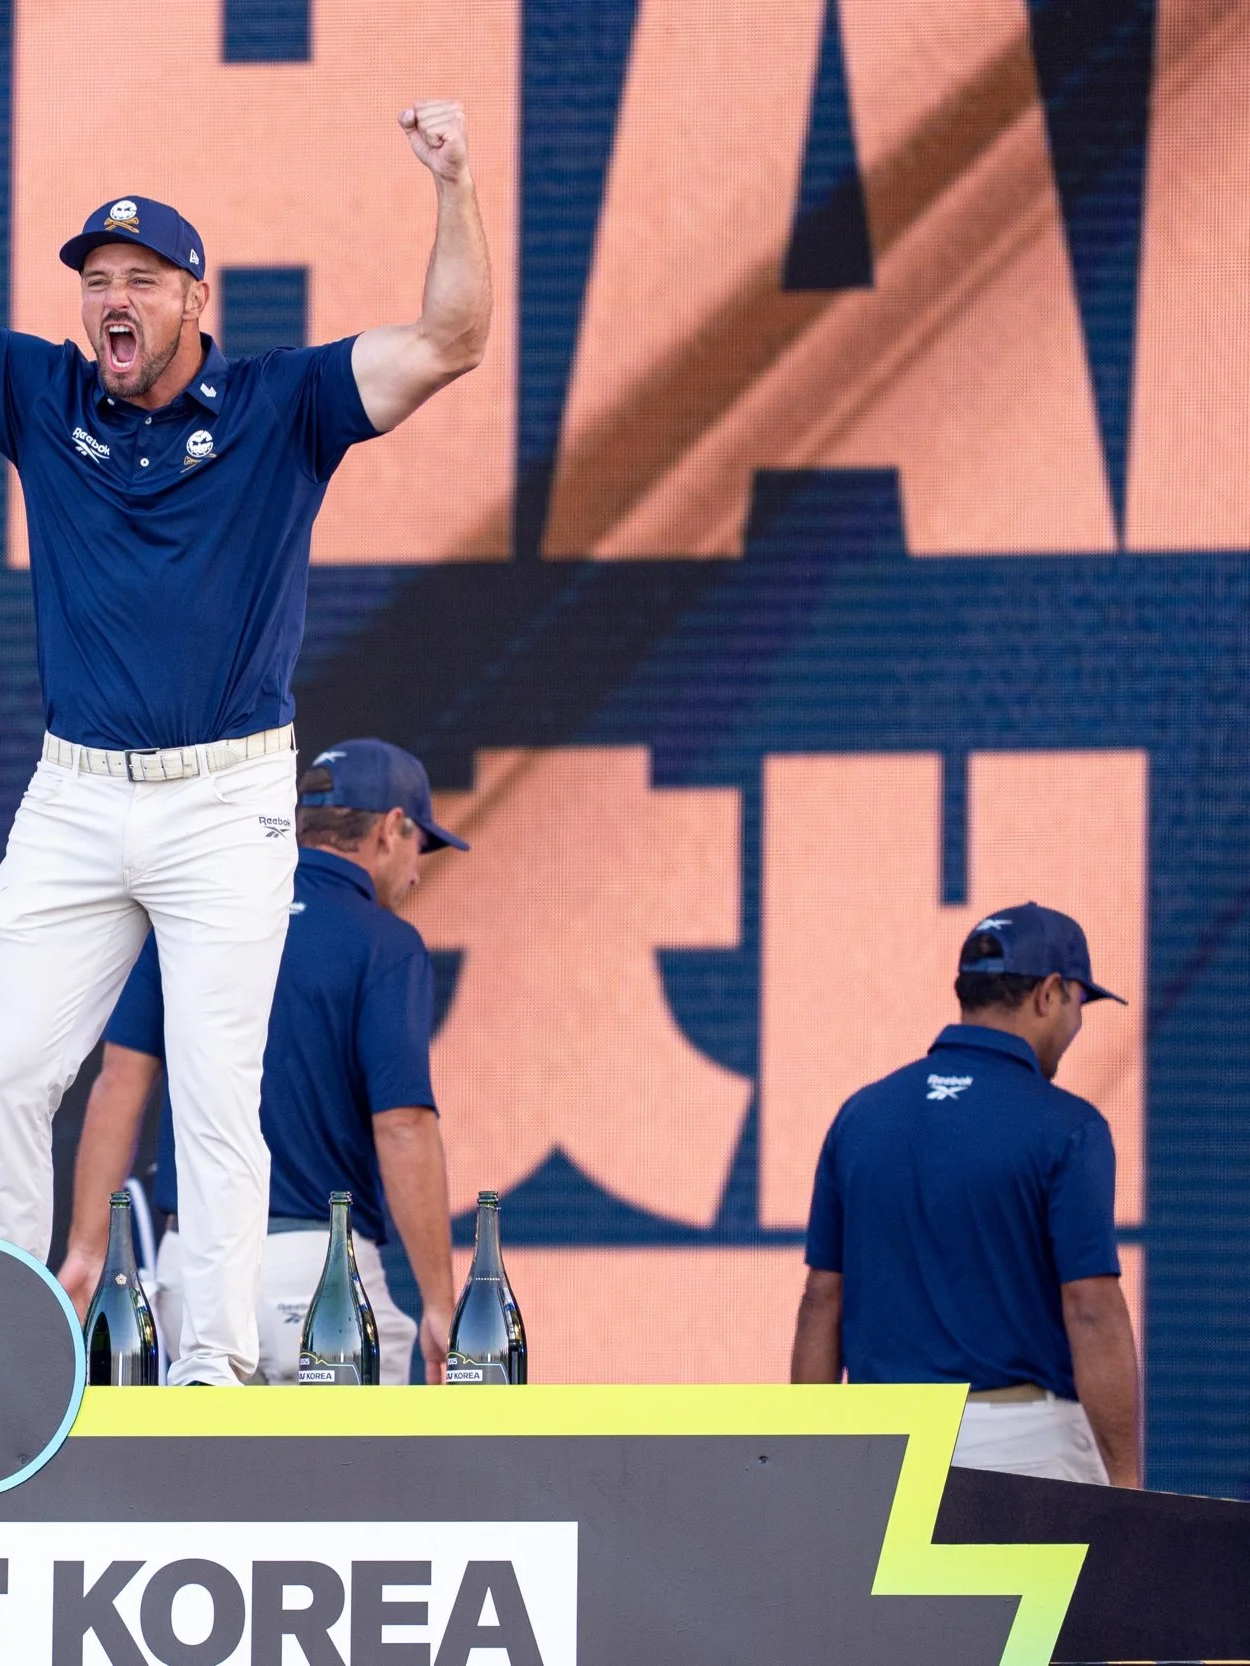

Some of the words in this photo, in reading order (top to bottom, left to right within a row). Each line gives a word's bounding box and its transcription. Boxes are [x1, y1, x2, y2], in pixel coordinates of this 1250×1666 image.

[72, 427, 110, 456] Reebok
[306, 1372, 333, 1380] KOREA
[453, 1372, 480, 1380] KOREA
[52, 1558, 546, 1666] KOREA
